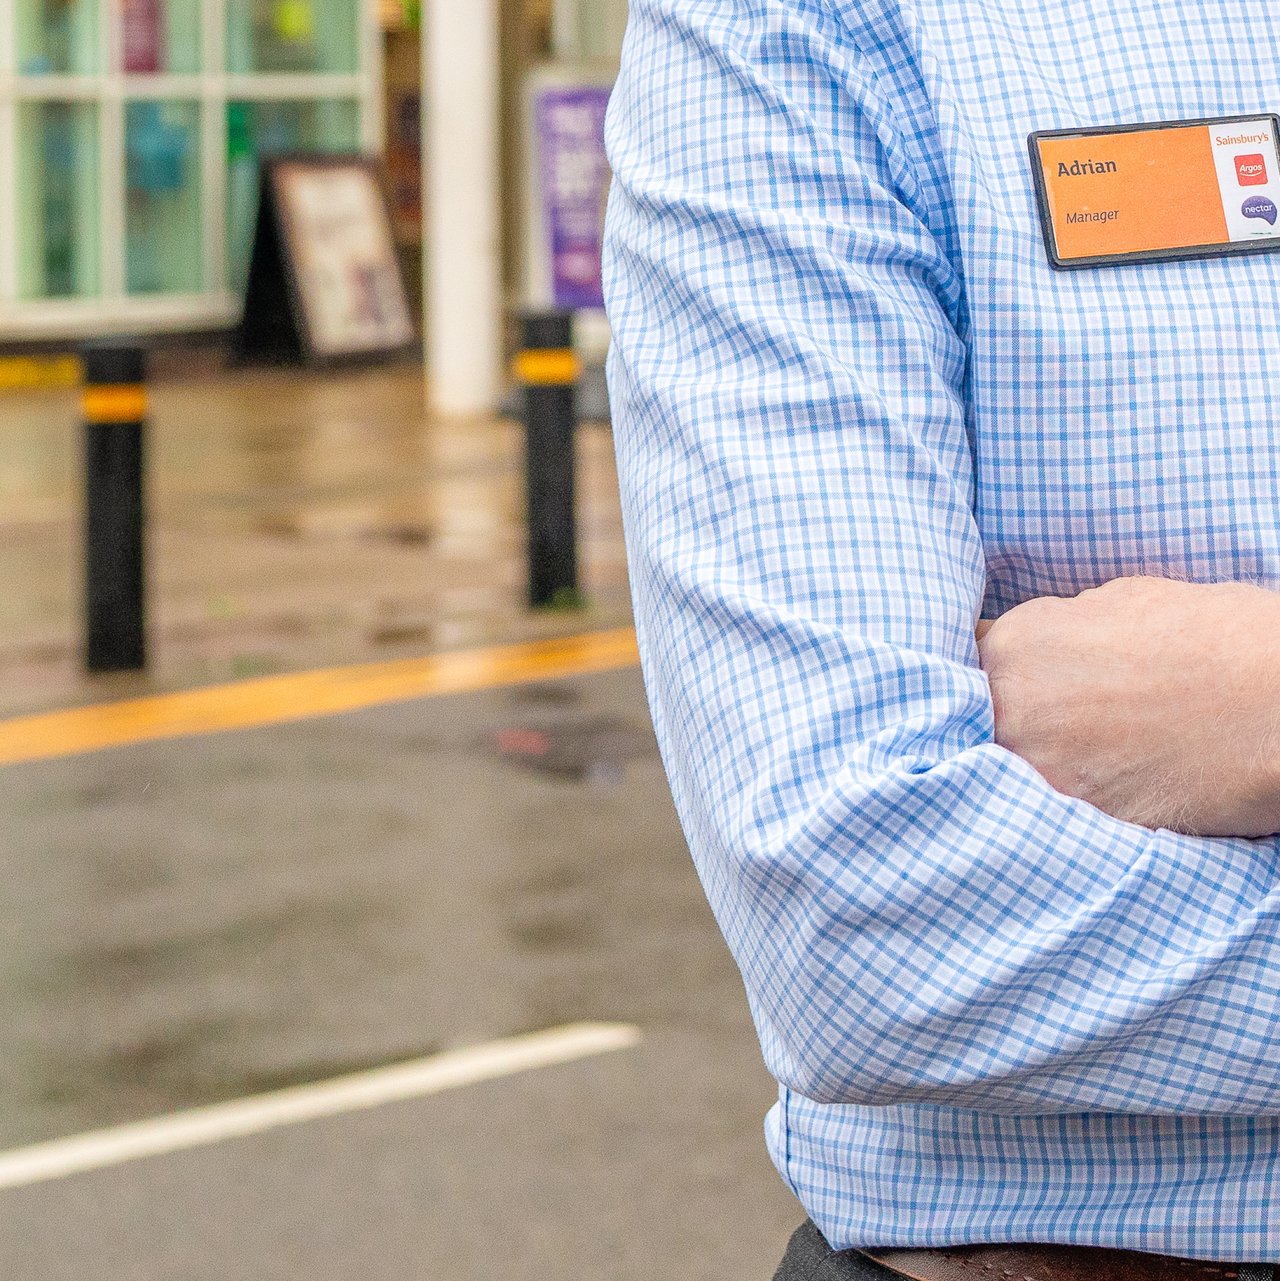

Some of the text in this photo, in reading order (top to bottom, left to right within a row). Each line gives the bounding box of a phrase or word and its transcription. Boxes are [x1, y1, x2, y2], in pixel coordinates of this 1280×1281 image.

[1215, 132, 1269, 146] Sainsbury's
[1057, 159, 1117, 177] Adrian
[1239, 163, 1263, 174] Argos
[1245, 204, 1273, 214] nectar
[1066, 209, 1120, 224] Manager
